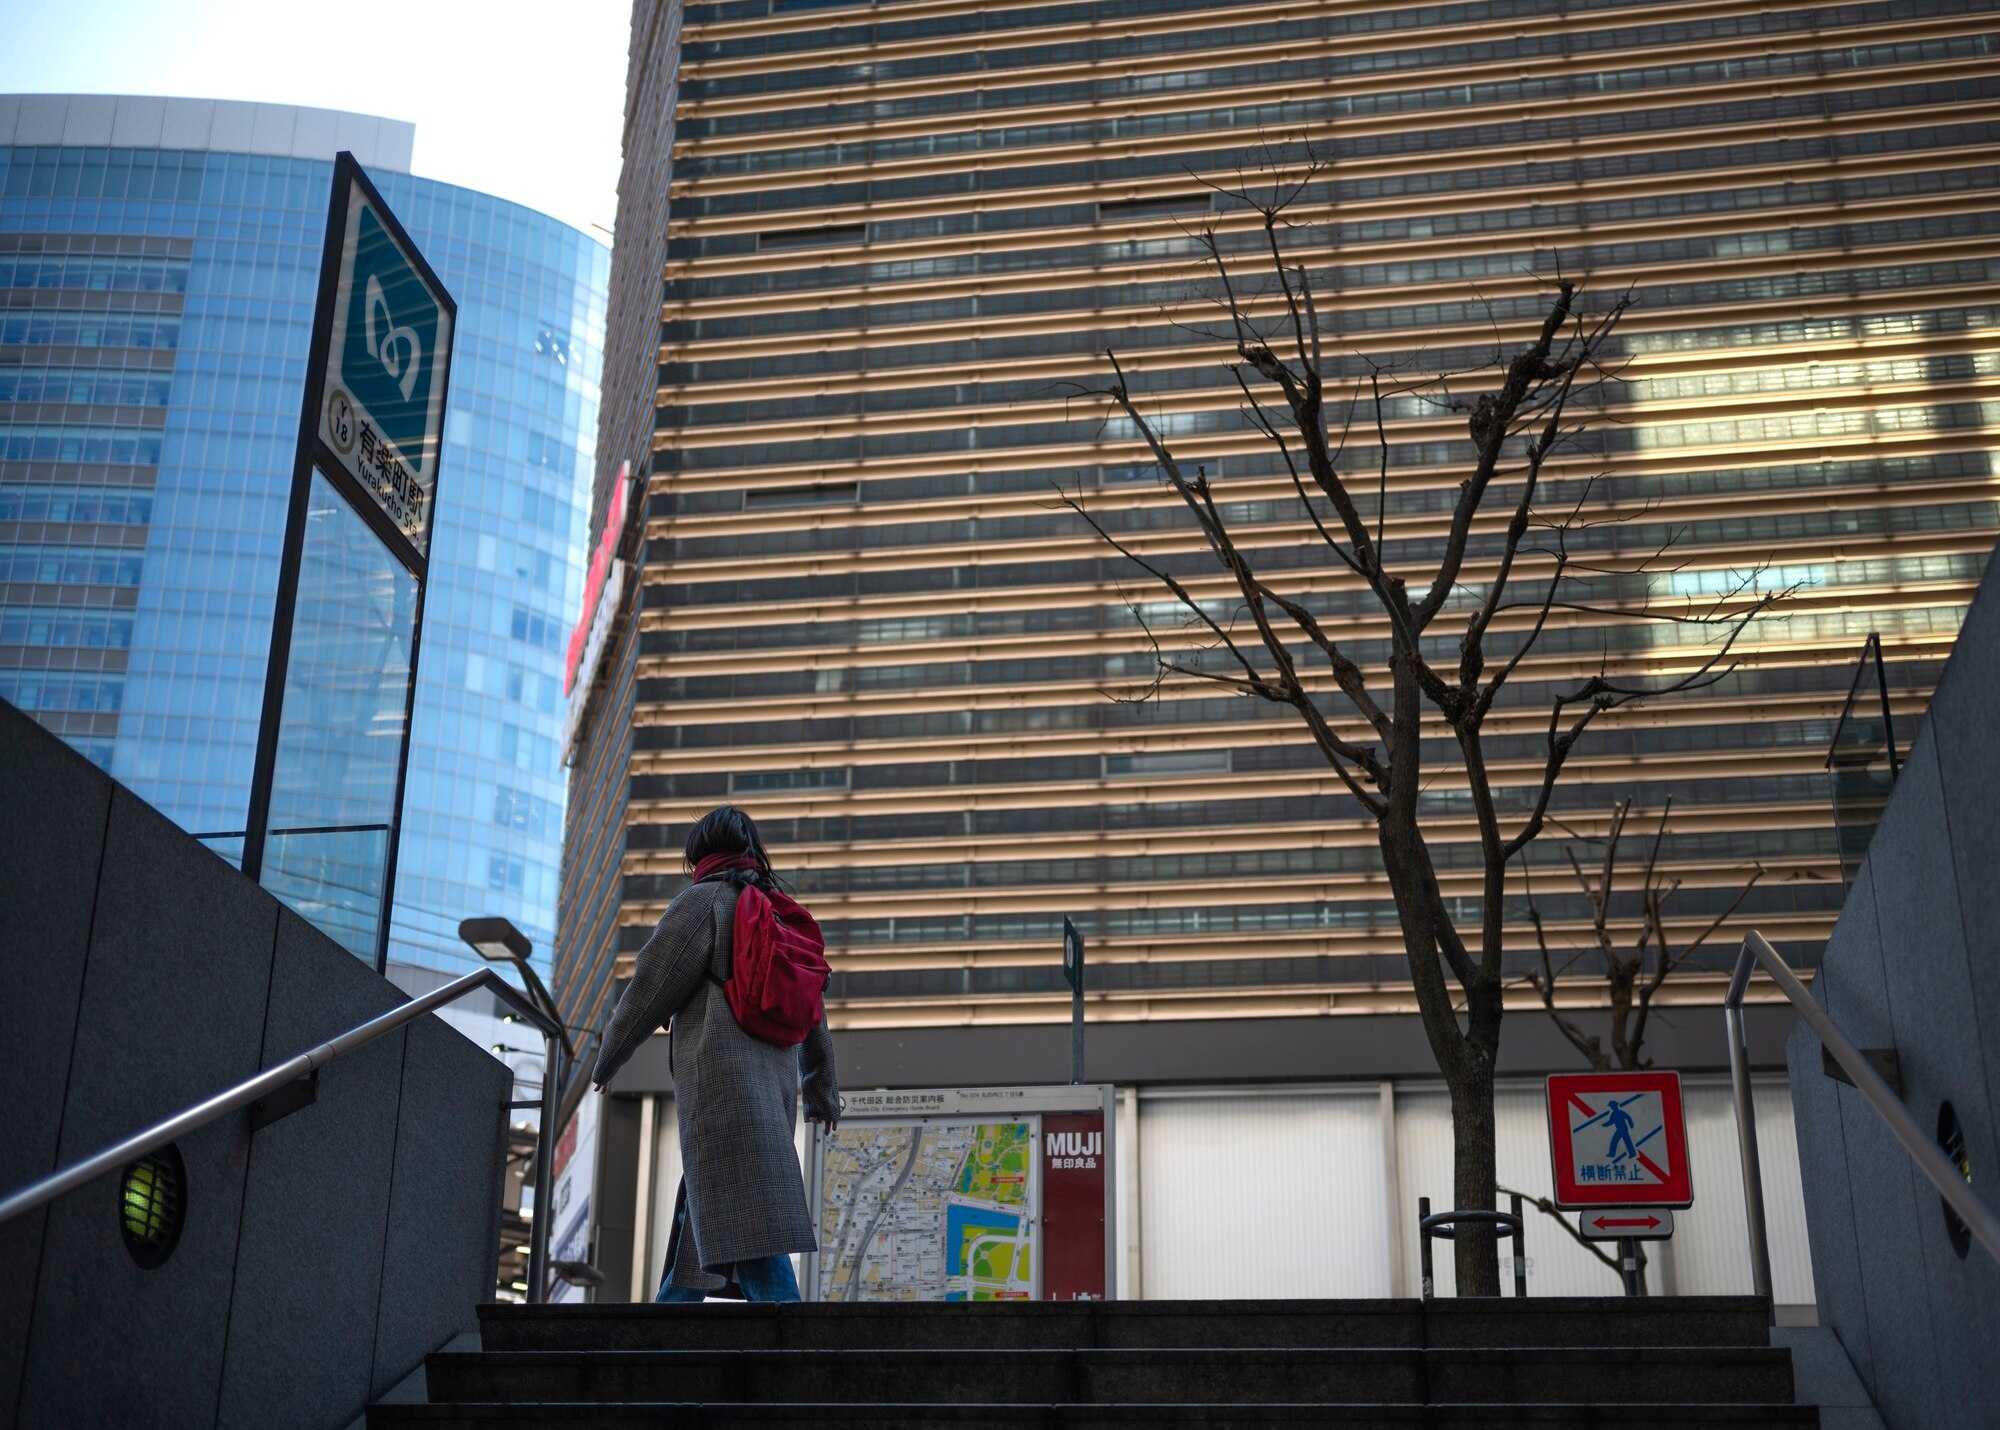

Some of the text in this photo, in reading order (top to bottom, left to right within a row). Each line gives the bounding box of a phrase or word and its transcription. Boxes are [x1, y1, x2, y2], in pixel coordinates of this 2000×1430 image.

[340, 401, 348, 418] Y
[335, 417, 348, 443] 18
[360, 419, 425, 523] 有楽町駅
[357, 456, 420, 541] Yurakucho Sta.
[850, 1096, 883, 1105] 千代田区
[1046, 1132, 1102, 1156] MUJI
[1052, 1157, 1096, 1169] 無印良品
[1581, 1164, 1644, 1182] 横断禁止
